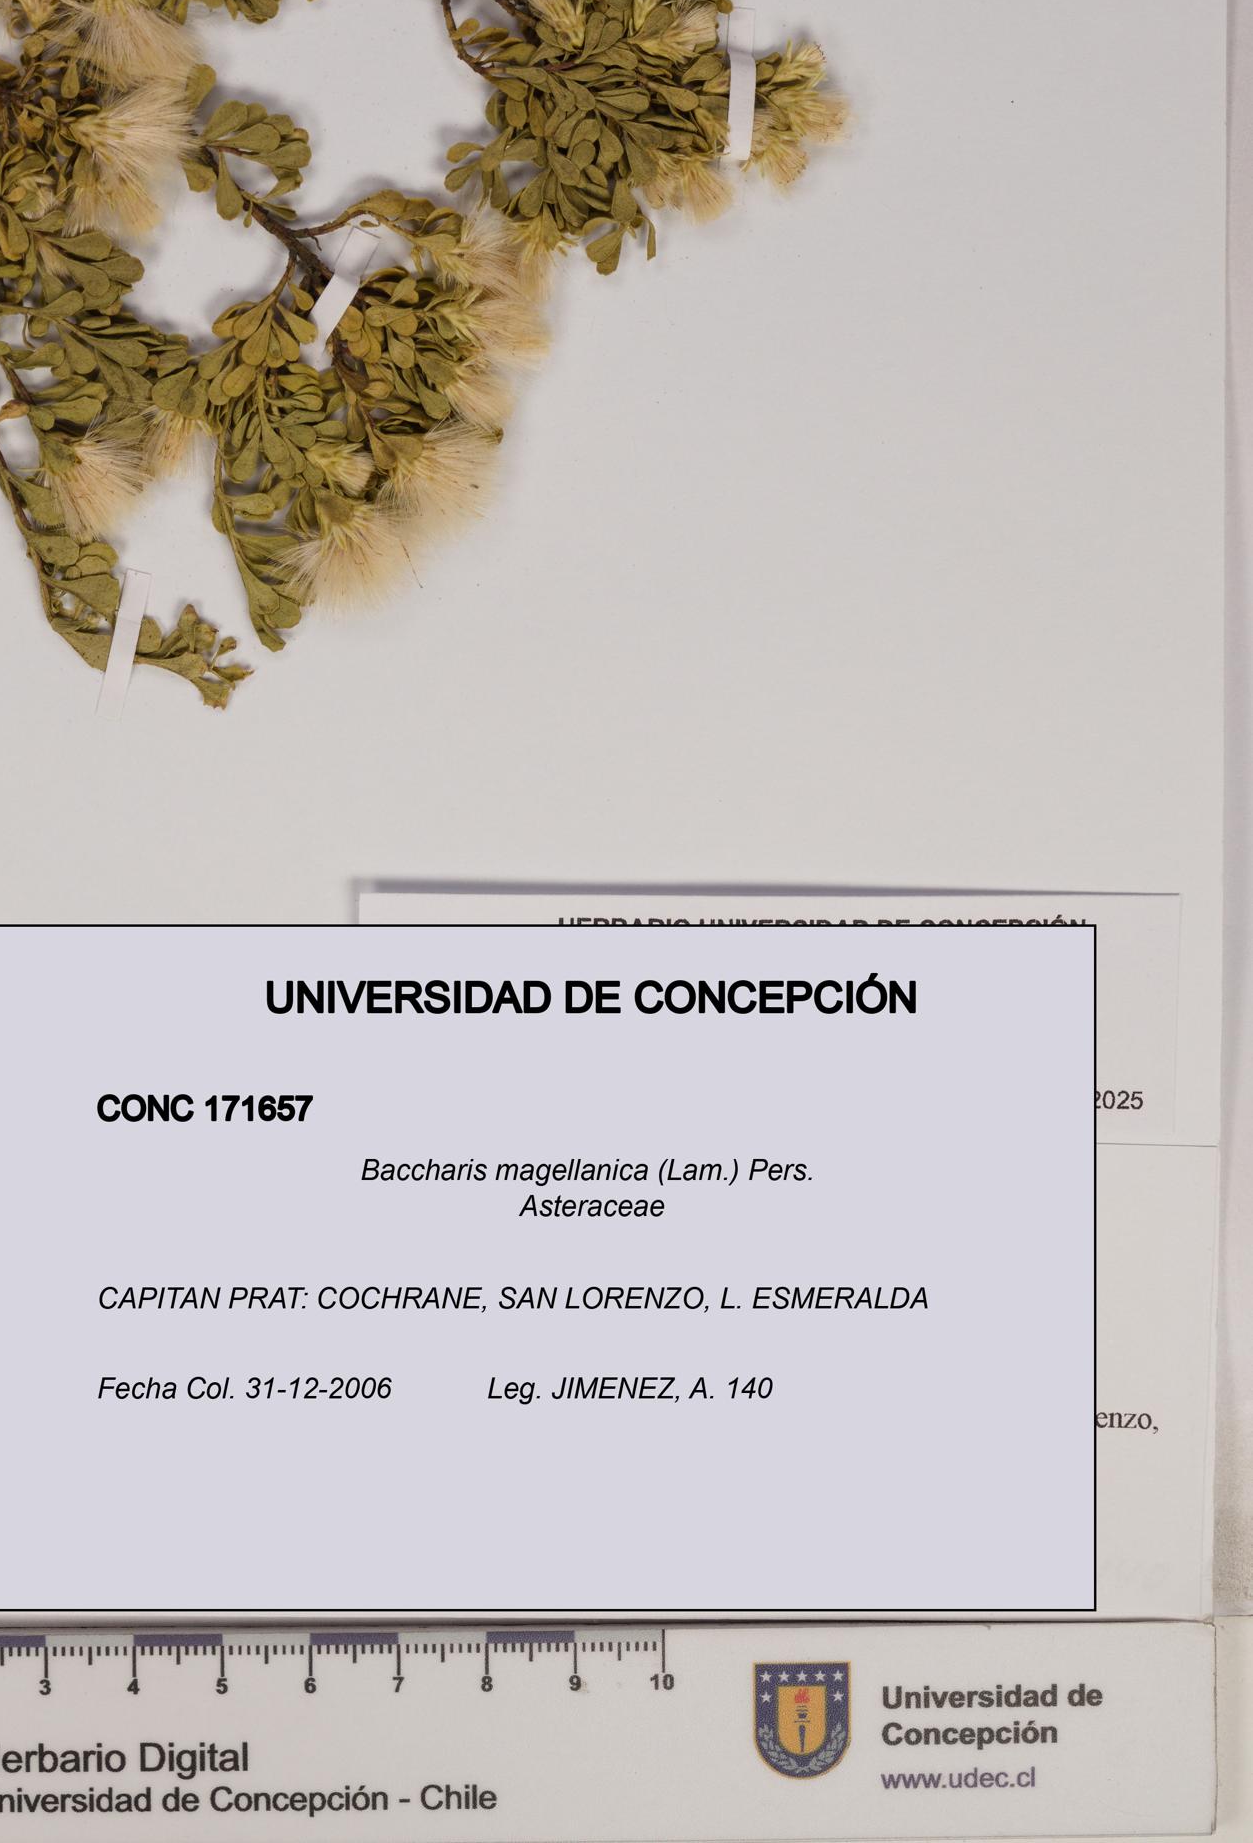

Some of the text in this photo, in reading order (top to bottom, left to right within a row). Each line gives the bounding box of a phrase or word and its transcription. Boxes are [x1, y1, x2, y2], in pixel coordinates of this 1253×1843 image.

[38, 1678, 52, 1696] 3
[126, 1678, 141, 1695] 4
[215, 1677, 229, 1695] 5
[303, 1677, 317, 1694] 6
[391, 1676, 405, 1693] 7
[480, 1675, 494, 1693] 8
[568, 1674, 582, 1692] 9
[649, 1673, 675, 1691] 10
[882, 1682, 1104, 1710] Universidad de
[881, 1718, 1058, 1751] Concepción
[139, 1741, 249, 1782] Digital
[880, 1765, 1036, 1791] www.udec.cl
[161, 1786, 201, 1813] de
[209, 1784, 389, 1818] Concepción
[419, 1783, 498, 1811] Chile
